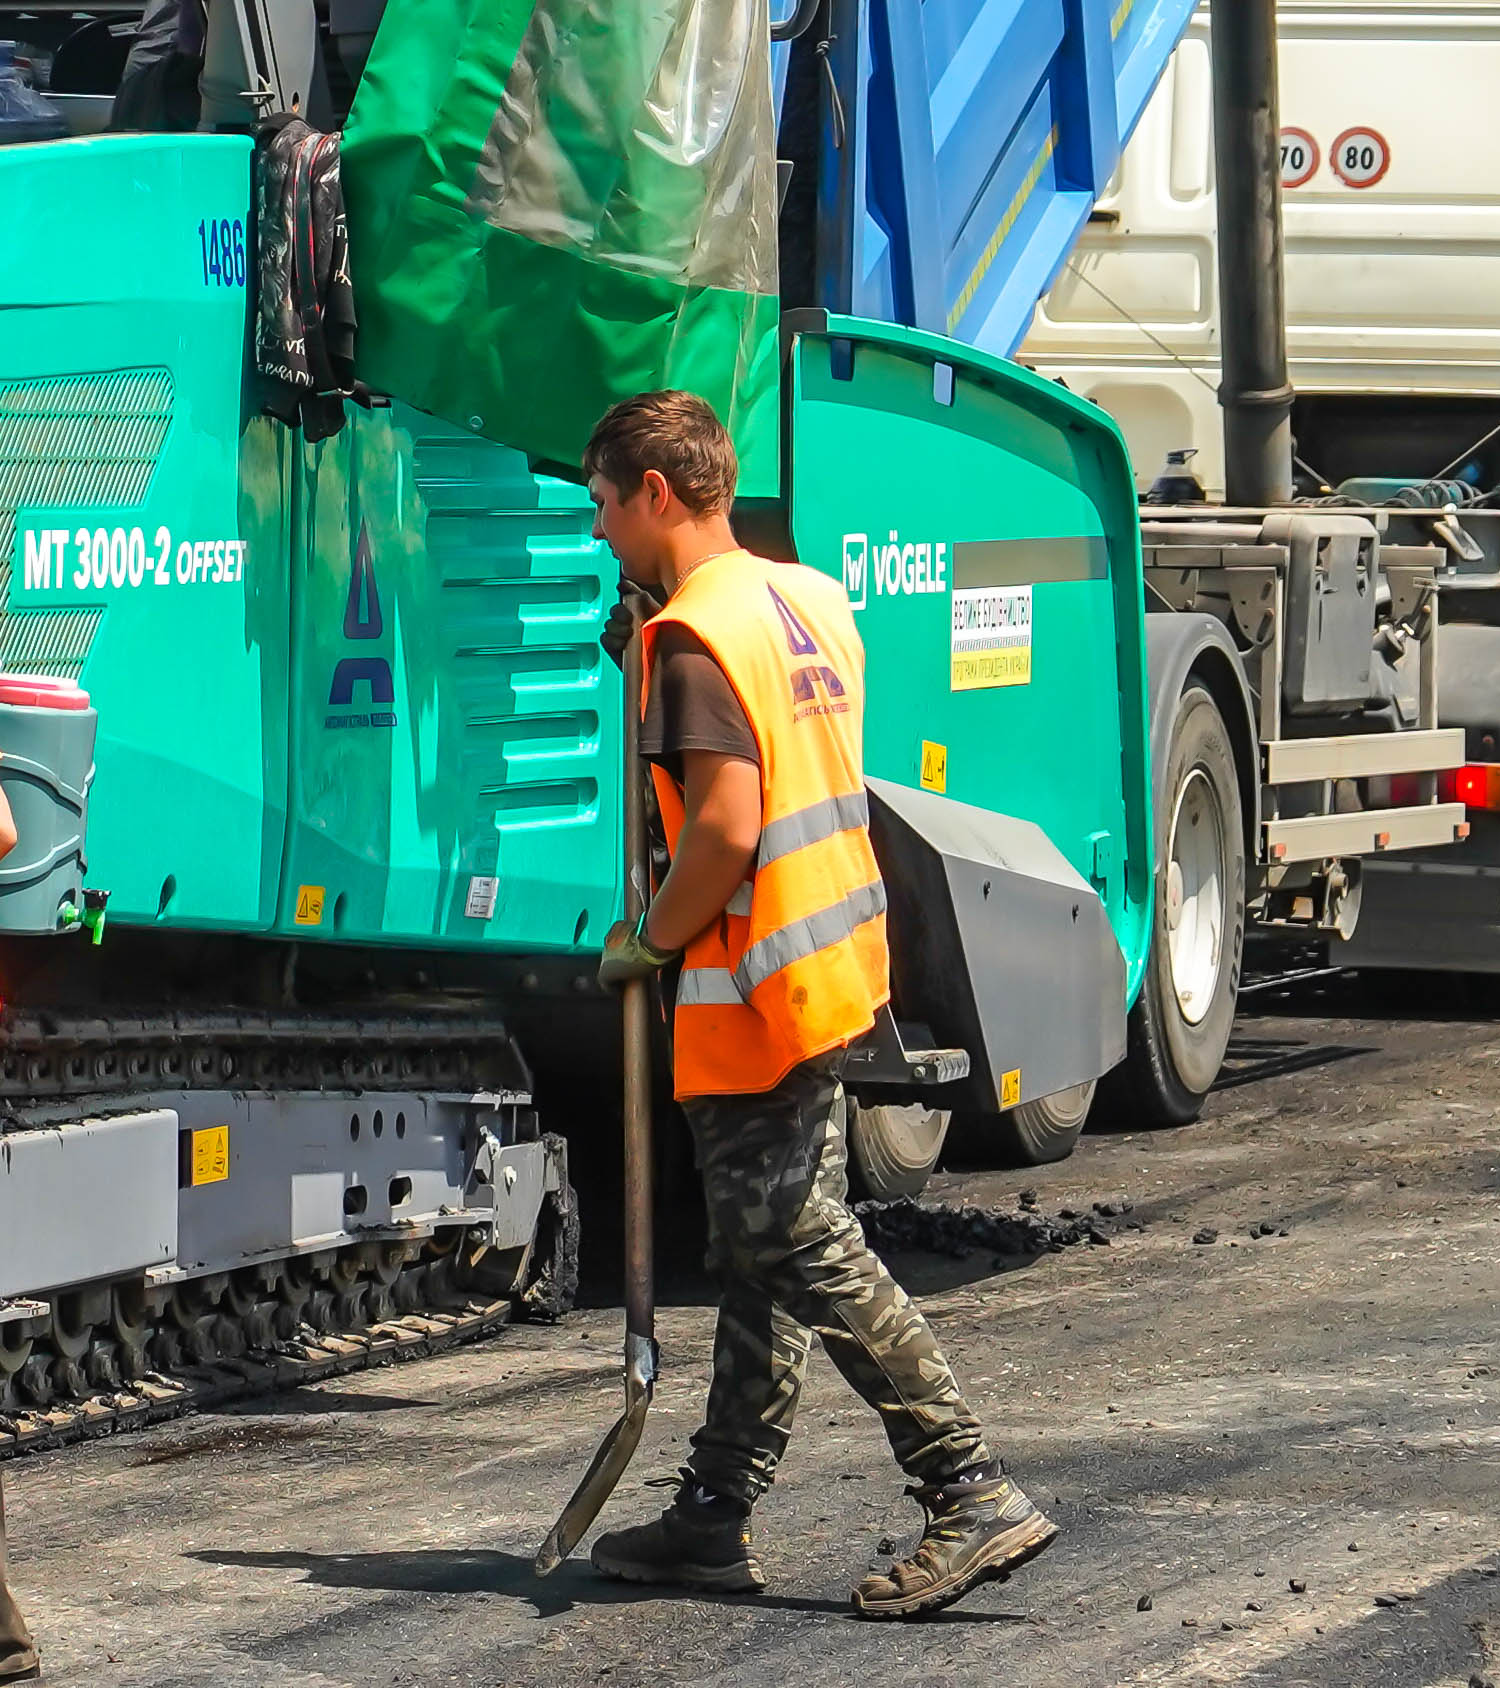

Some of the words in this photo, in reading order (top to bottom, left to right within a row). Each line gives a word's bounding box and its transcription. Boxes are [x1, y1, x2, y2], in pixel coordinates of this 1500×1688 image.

[1345, 146, 1375, 170] 80
[198, 218, 246, 287] 1486
[24, 529, 70, 590] MT
[72, 525, 172, 590] 3000-2
[176, 539, 248, 585] OFFSET
[872, 529, 947, 596] VÖGELE
